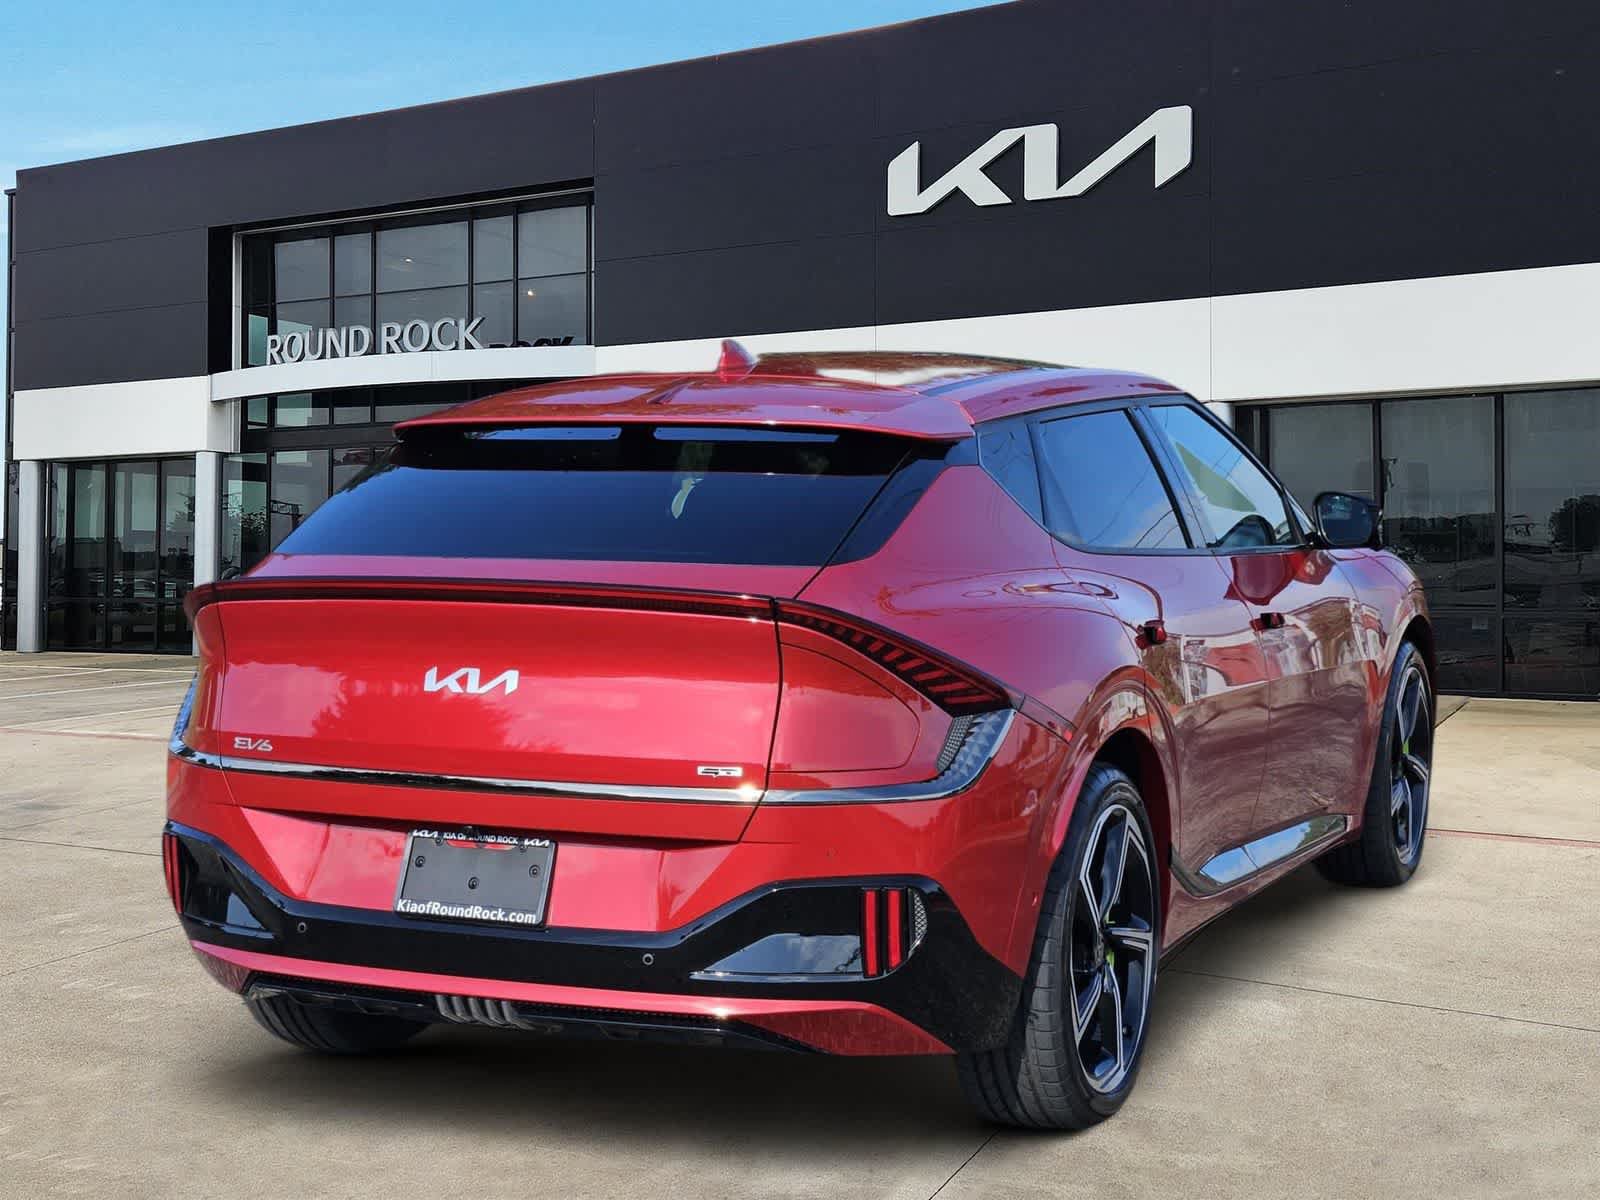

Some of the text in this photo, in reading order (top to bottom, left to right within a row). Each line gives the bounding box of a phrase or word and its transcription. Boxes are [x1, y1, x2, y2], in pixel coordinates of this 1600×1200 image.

[887, 104, 1193, 216] KIA
[266, 316, 484, 366] ROUND ROCK
[423, 666, 520, 696] KIA
[233, 736, 273, 752] EV6
[468, 834, 496, 843] OUND
[496, 835, 519, 845] ROCK
[396, 898, 537, 925] KiaofRoundRock.com
